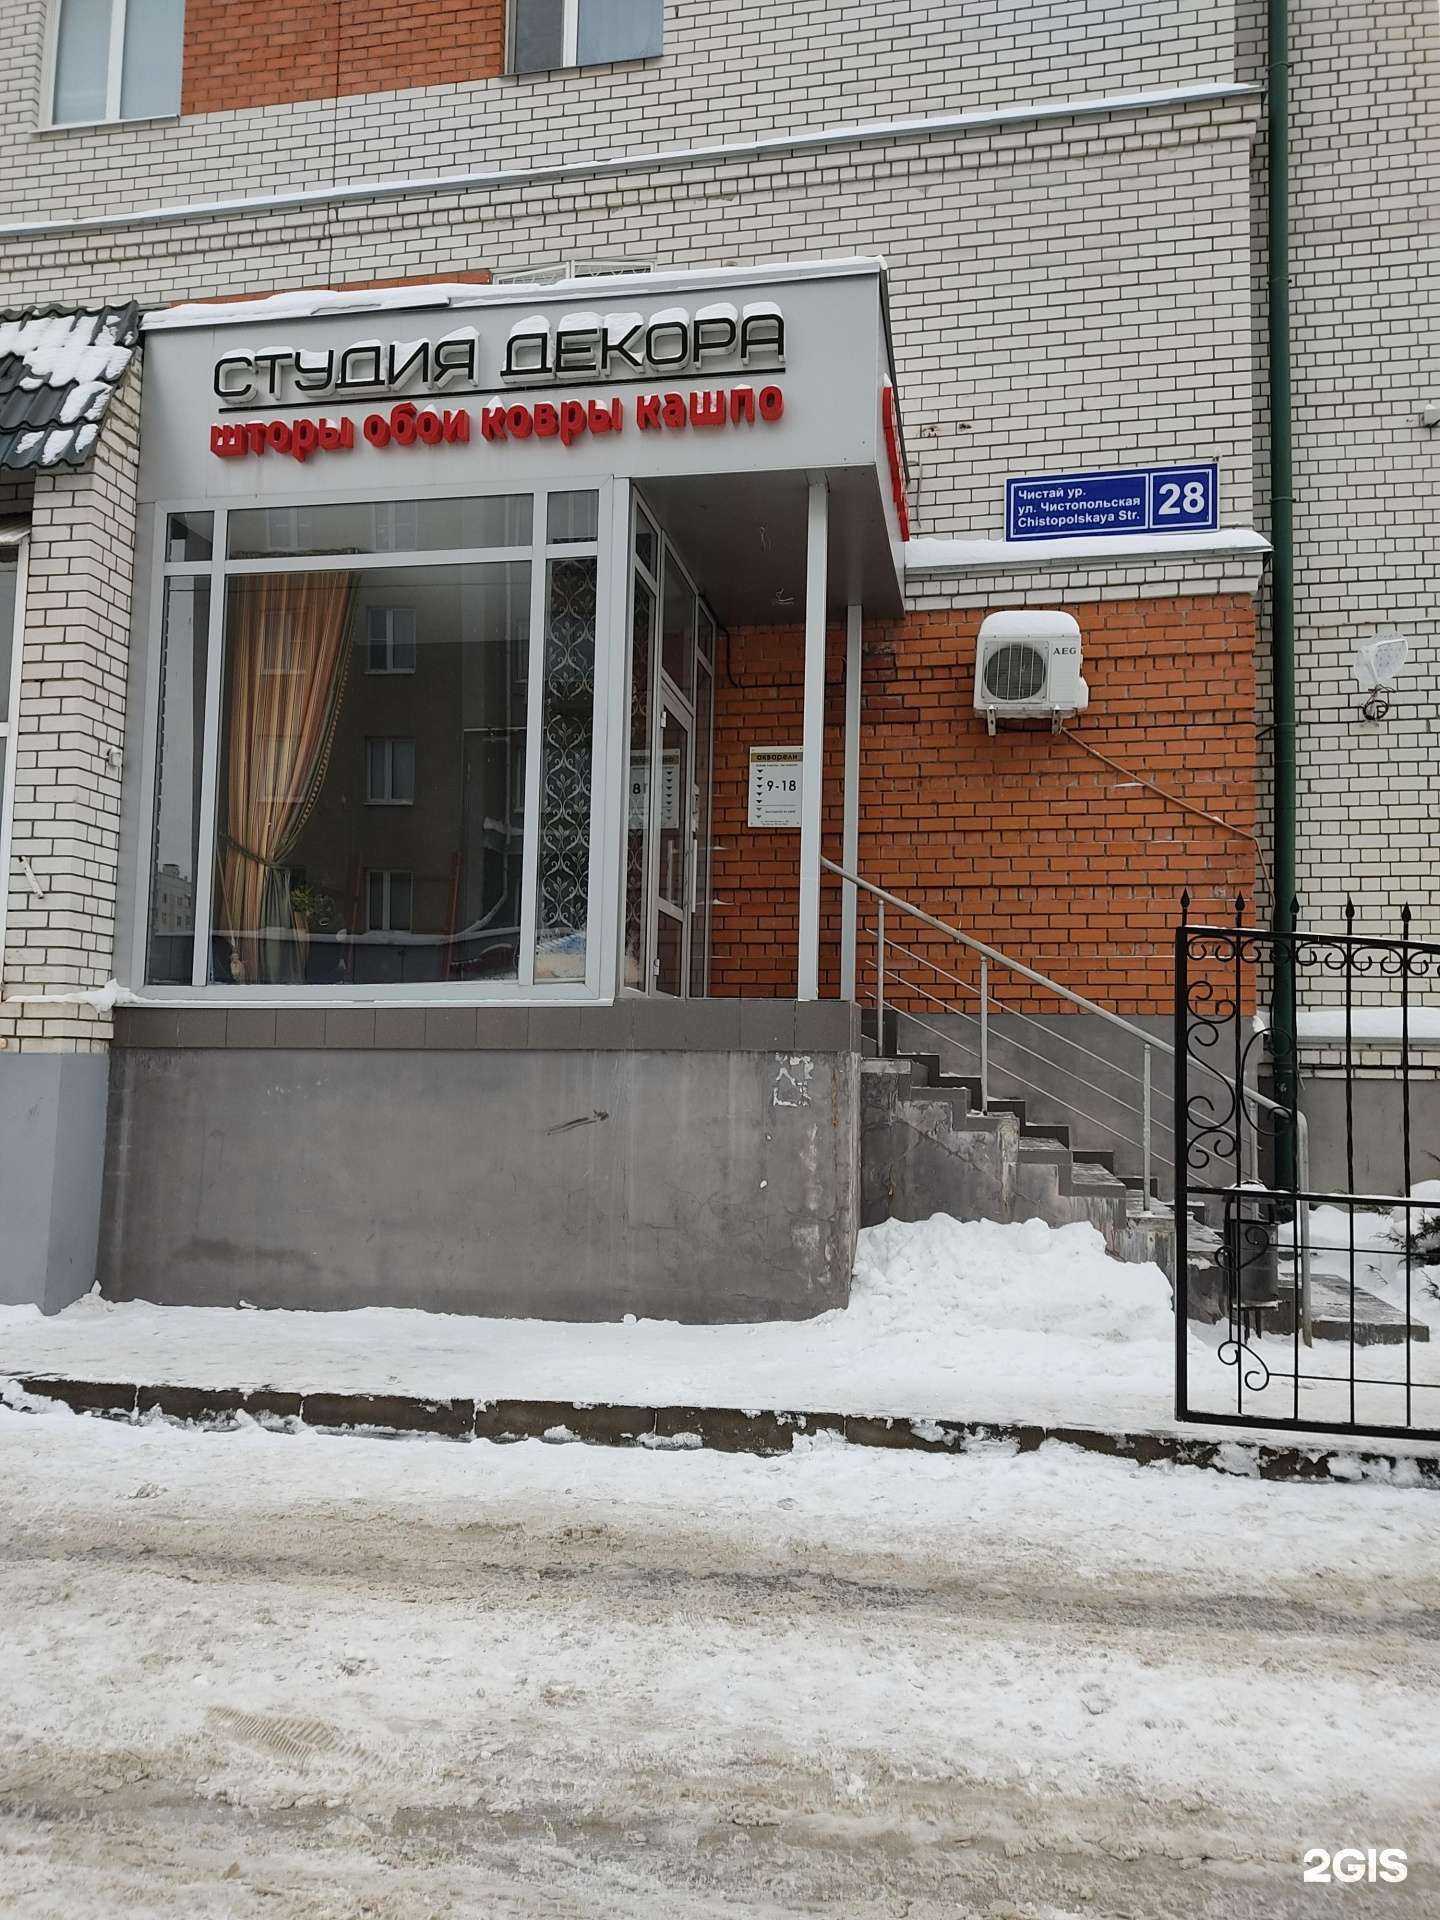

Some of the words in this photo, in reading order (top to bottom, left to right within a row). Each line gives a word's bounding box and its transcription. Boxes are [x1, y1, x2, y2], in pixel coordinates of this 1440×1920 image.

[213, 336, 479, 401] СТУДИЯ
[500, 312, 786, 379] ДЕКОРА
[210, 416, 354, 463] шторы
[363, 402, 470, 448] обои
[481, 398, 623, 447] ковры
[636, 385, 785, 430] кашпо
[1018, 487, 1064, 500] Чистай
[1067, 488, 1087, 501] ур.
[1158, 481, 1205, 516] 28
[1018, 505, 1037, 516] ул.
[1040, 497, 1141, 512] Чистопольская
[1018, 511, 1115, 529] Chistopolskaya
[1118, 510, 1140, 521] Str.
[1052, 647, 1077, 655] AEG
[766, 780, 797, 792] 9-18
